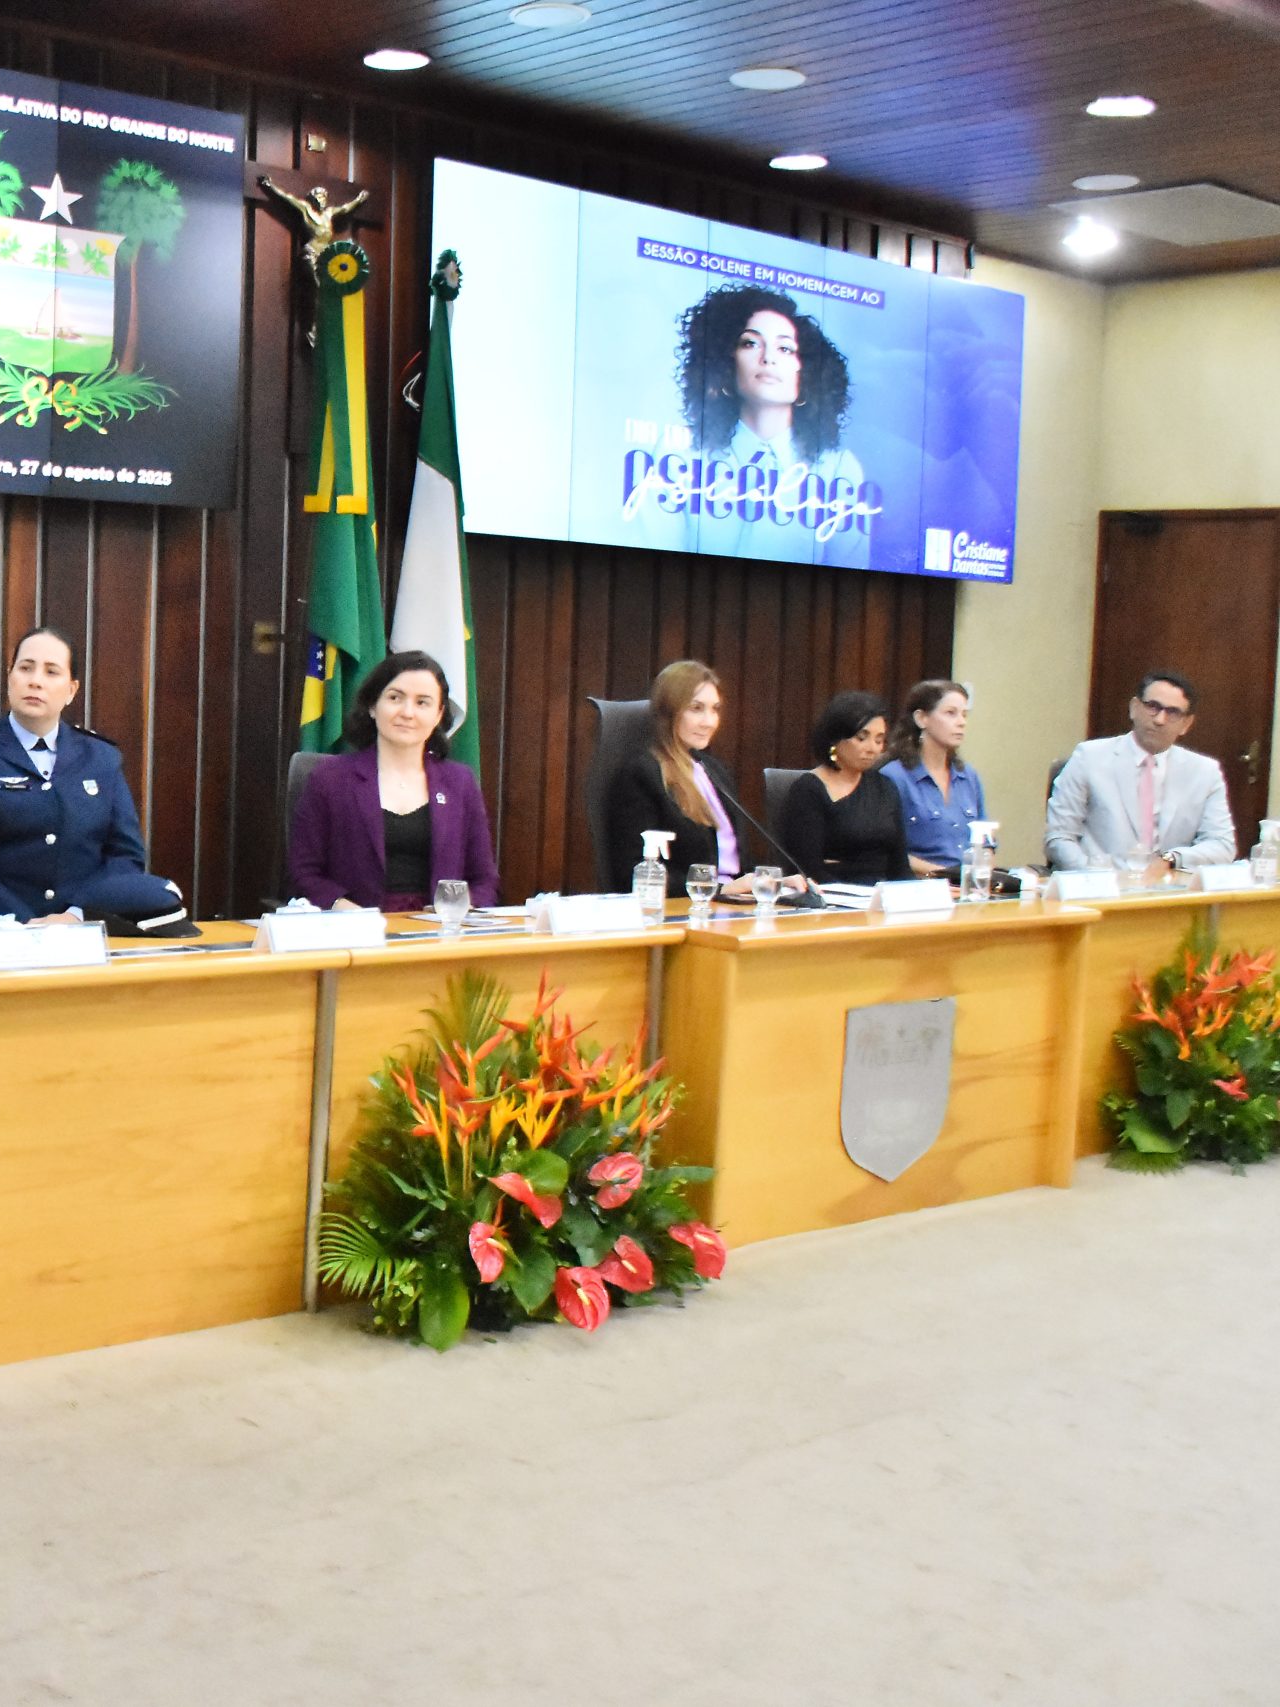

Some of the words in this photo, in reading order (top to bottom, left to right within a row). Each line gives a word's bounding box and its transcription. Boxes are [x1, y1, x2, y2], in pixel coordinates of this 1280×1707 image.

[60, 105, 82, 125] DO
[83, 111, 108, 130] RIO
[109, 116, 167, 142] GRANDE
[168, 127, 190, 144] DO
[190, 131, 235, 154] NORTE
[643, 241, 697, 266] SESSÃO
[700, 254, 751, 278] SOLENE
[754, 265, 775, 282] EM
[777, 271, 858, 300] HOMENAGEM
[860, 290, 881, 306] AO
[20, 460, 40, 476] 27
[42, 462, 63, 477] de
[64, 465, 115, 483] agosto
[116, 470, 135, 483] de
[137, 469, 173, 486] 2025
[953, 531, 1008, 562] Cristiane
